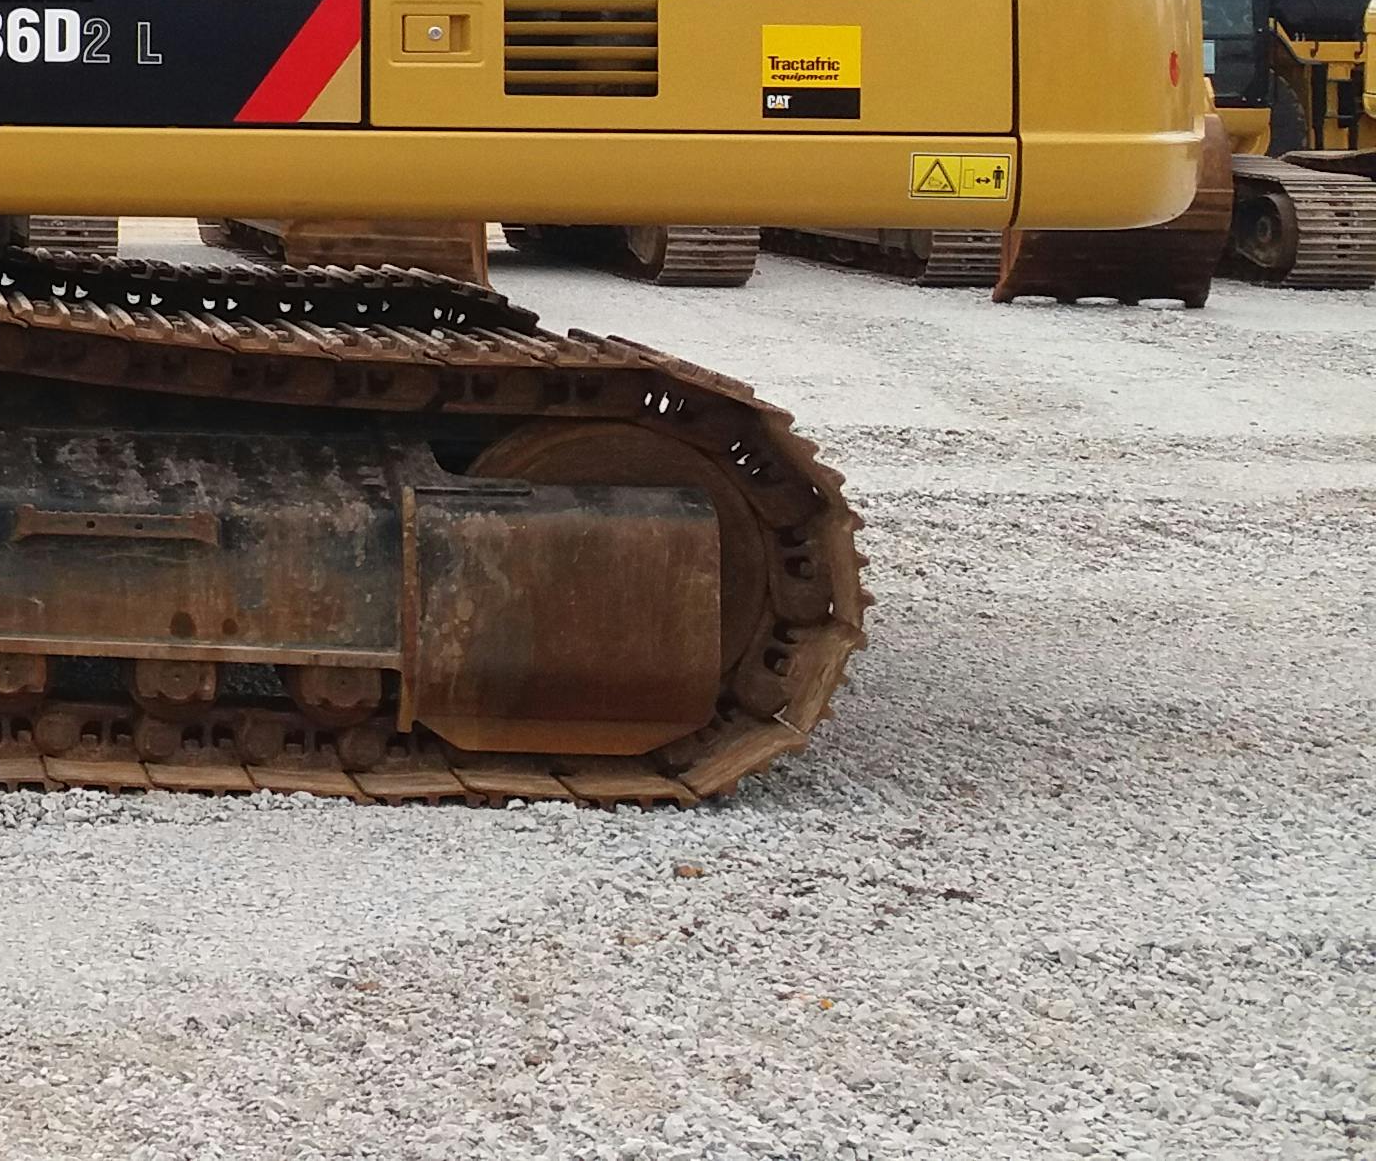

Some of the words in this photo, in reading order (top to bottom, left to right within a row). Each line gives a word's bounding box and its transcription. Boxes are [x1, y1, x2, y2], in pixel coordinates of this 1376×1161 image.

[137, 21, 163, 65] L
[768, 56, 841, 71] Tractafric
[771, 73, 840, 82] equipment
[767, 95, 792, 109] CAT
